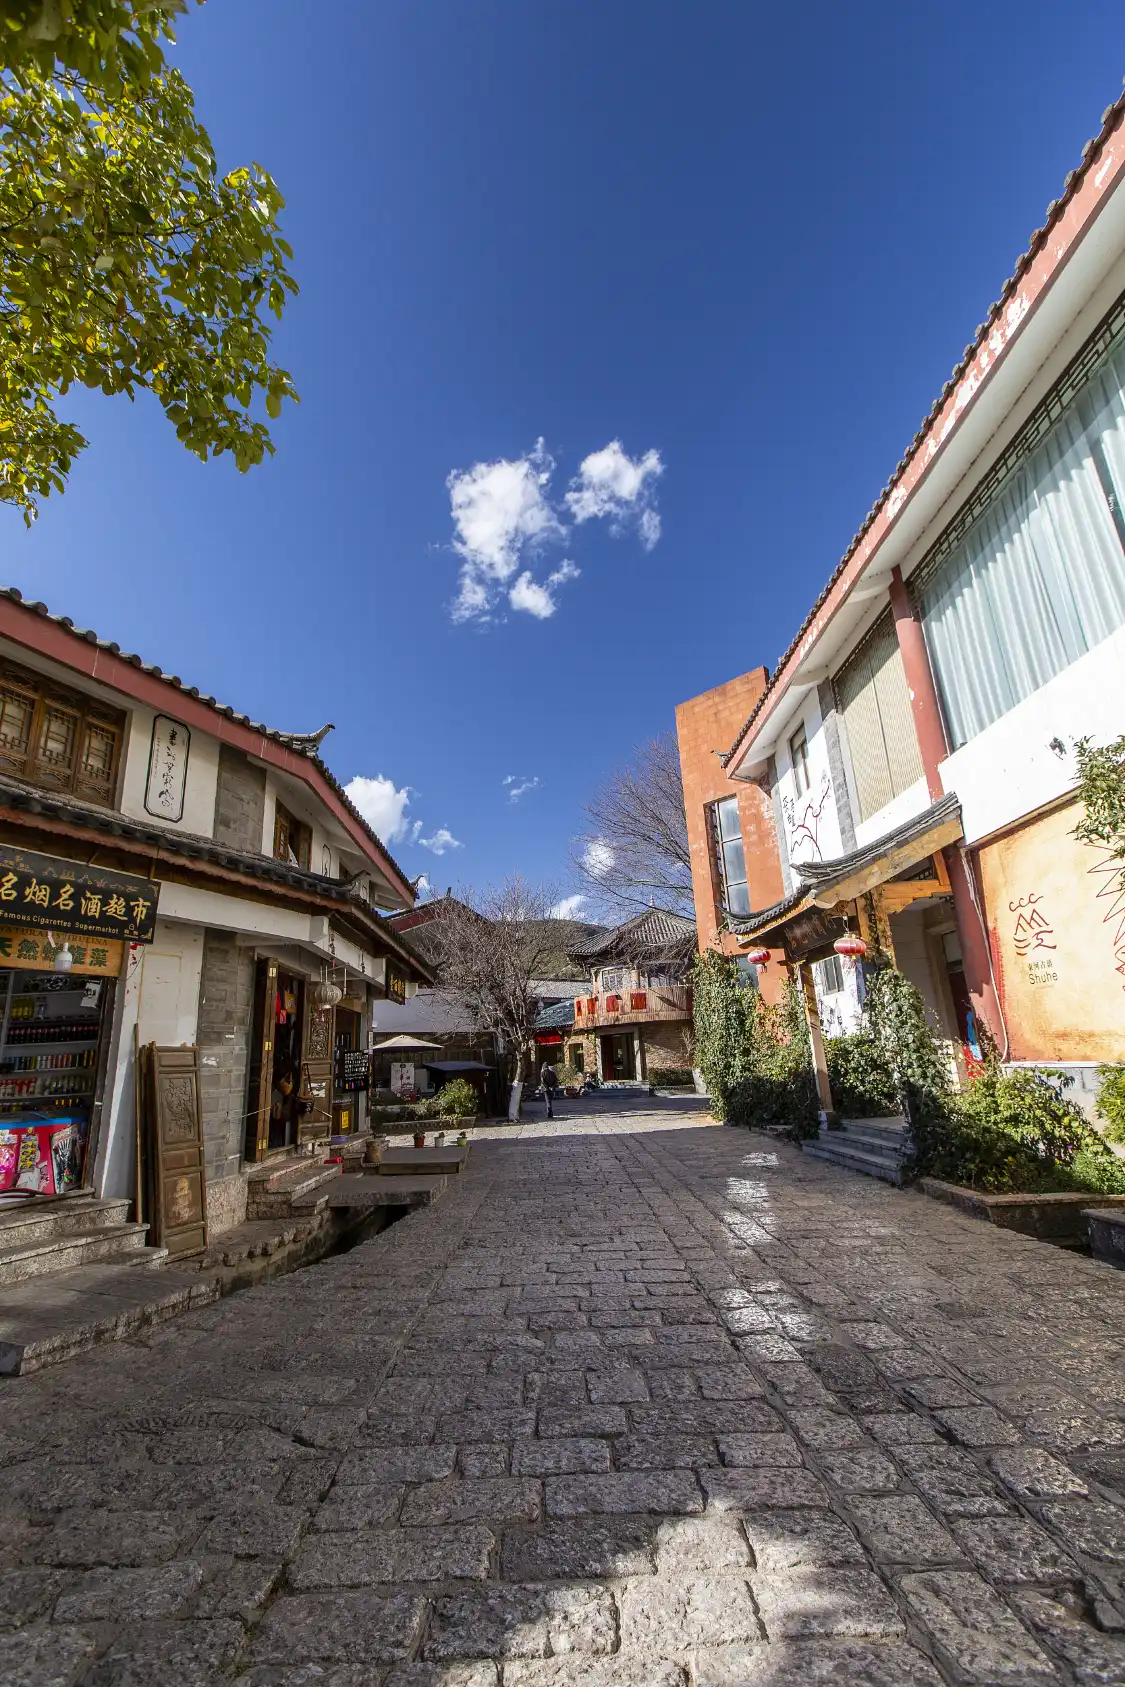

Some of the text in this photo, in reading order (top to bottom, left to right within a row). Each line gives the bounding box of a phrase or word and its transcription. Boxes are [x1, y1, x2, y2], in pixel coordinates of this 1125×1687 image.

[0, 872, 151, 927] 名烟名酒超市
[0, 910, 31, 921] Famous
[32, 913, 72, 928] Cigarettes
[1029, 971, 1058, 985] Shuhe
